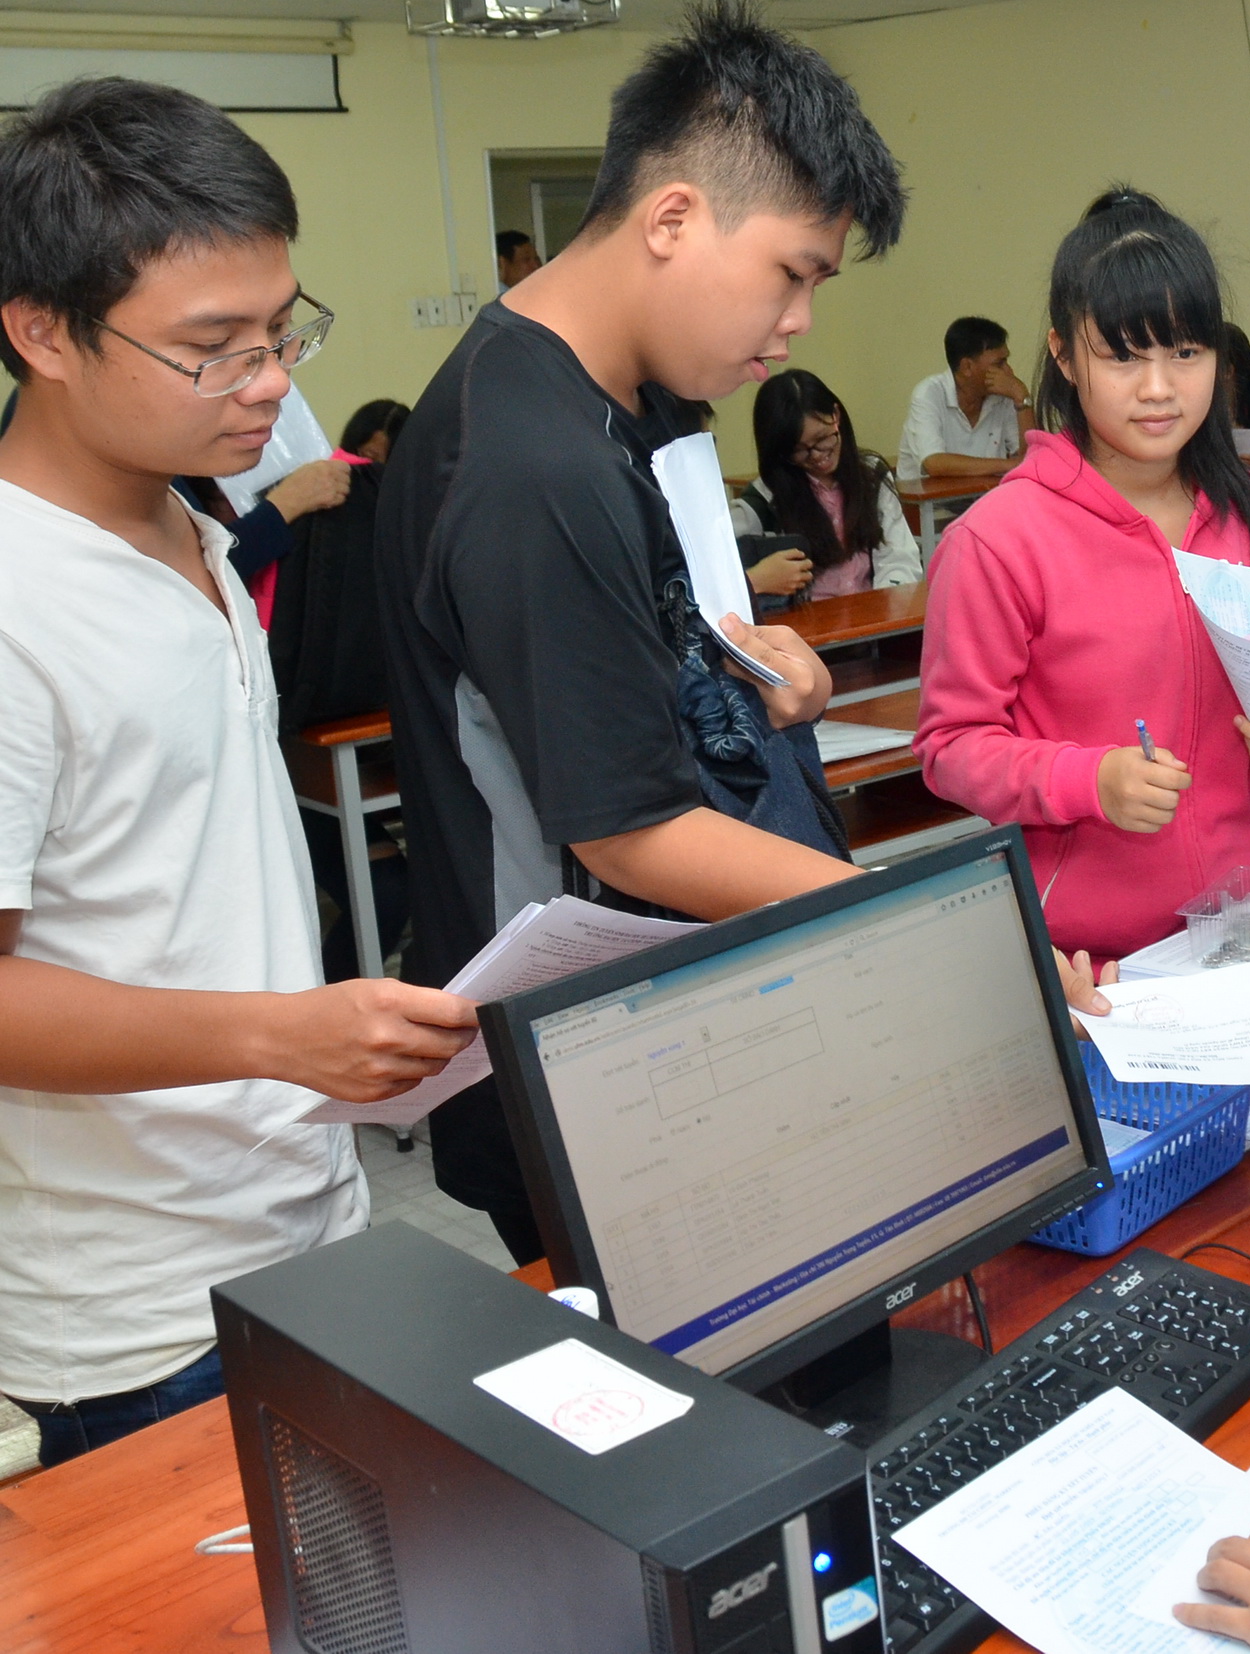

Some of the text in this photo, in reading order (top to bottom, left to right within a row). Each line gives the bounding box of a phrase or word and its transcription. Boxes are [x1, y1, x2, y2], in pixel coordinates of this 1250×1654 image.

[886, 1281, 917, 1310] acer
[1112, 1270, 1144, 1297] acer
[708, 1561, 778, 1620] acer
